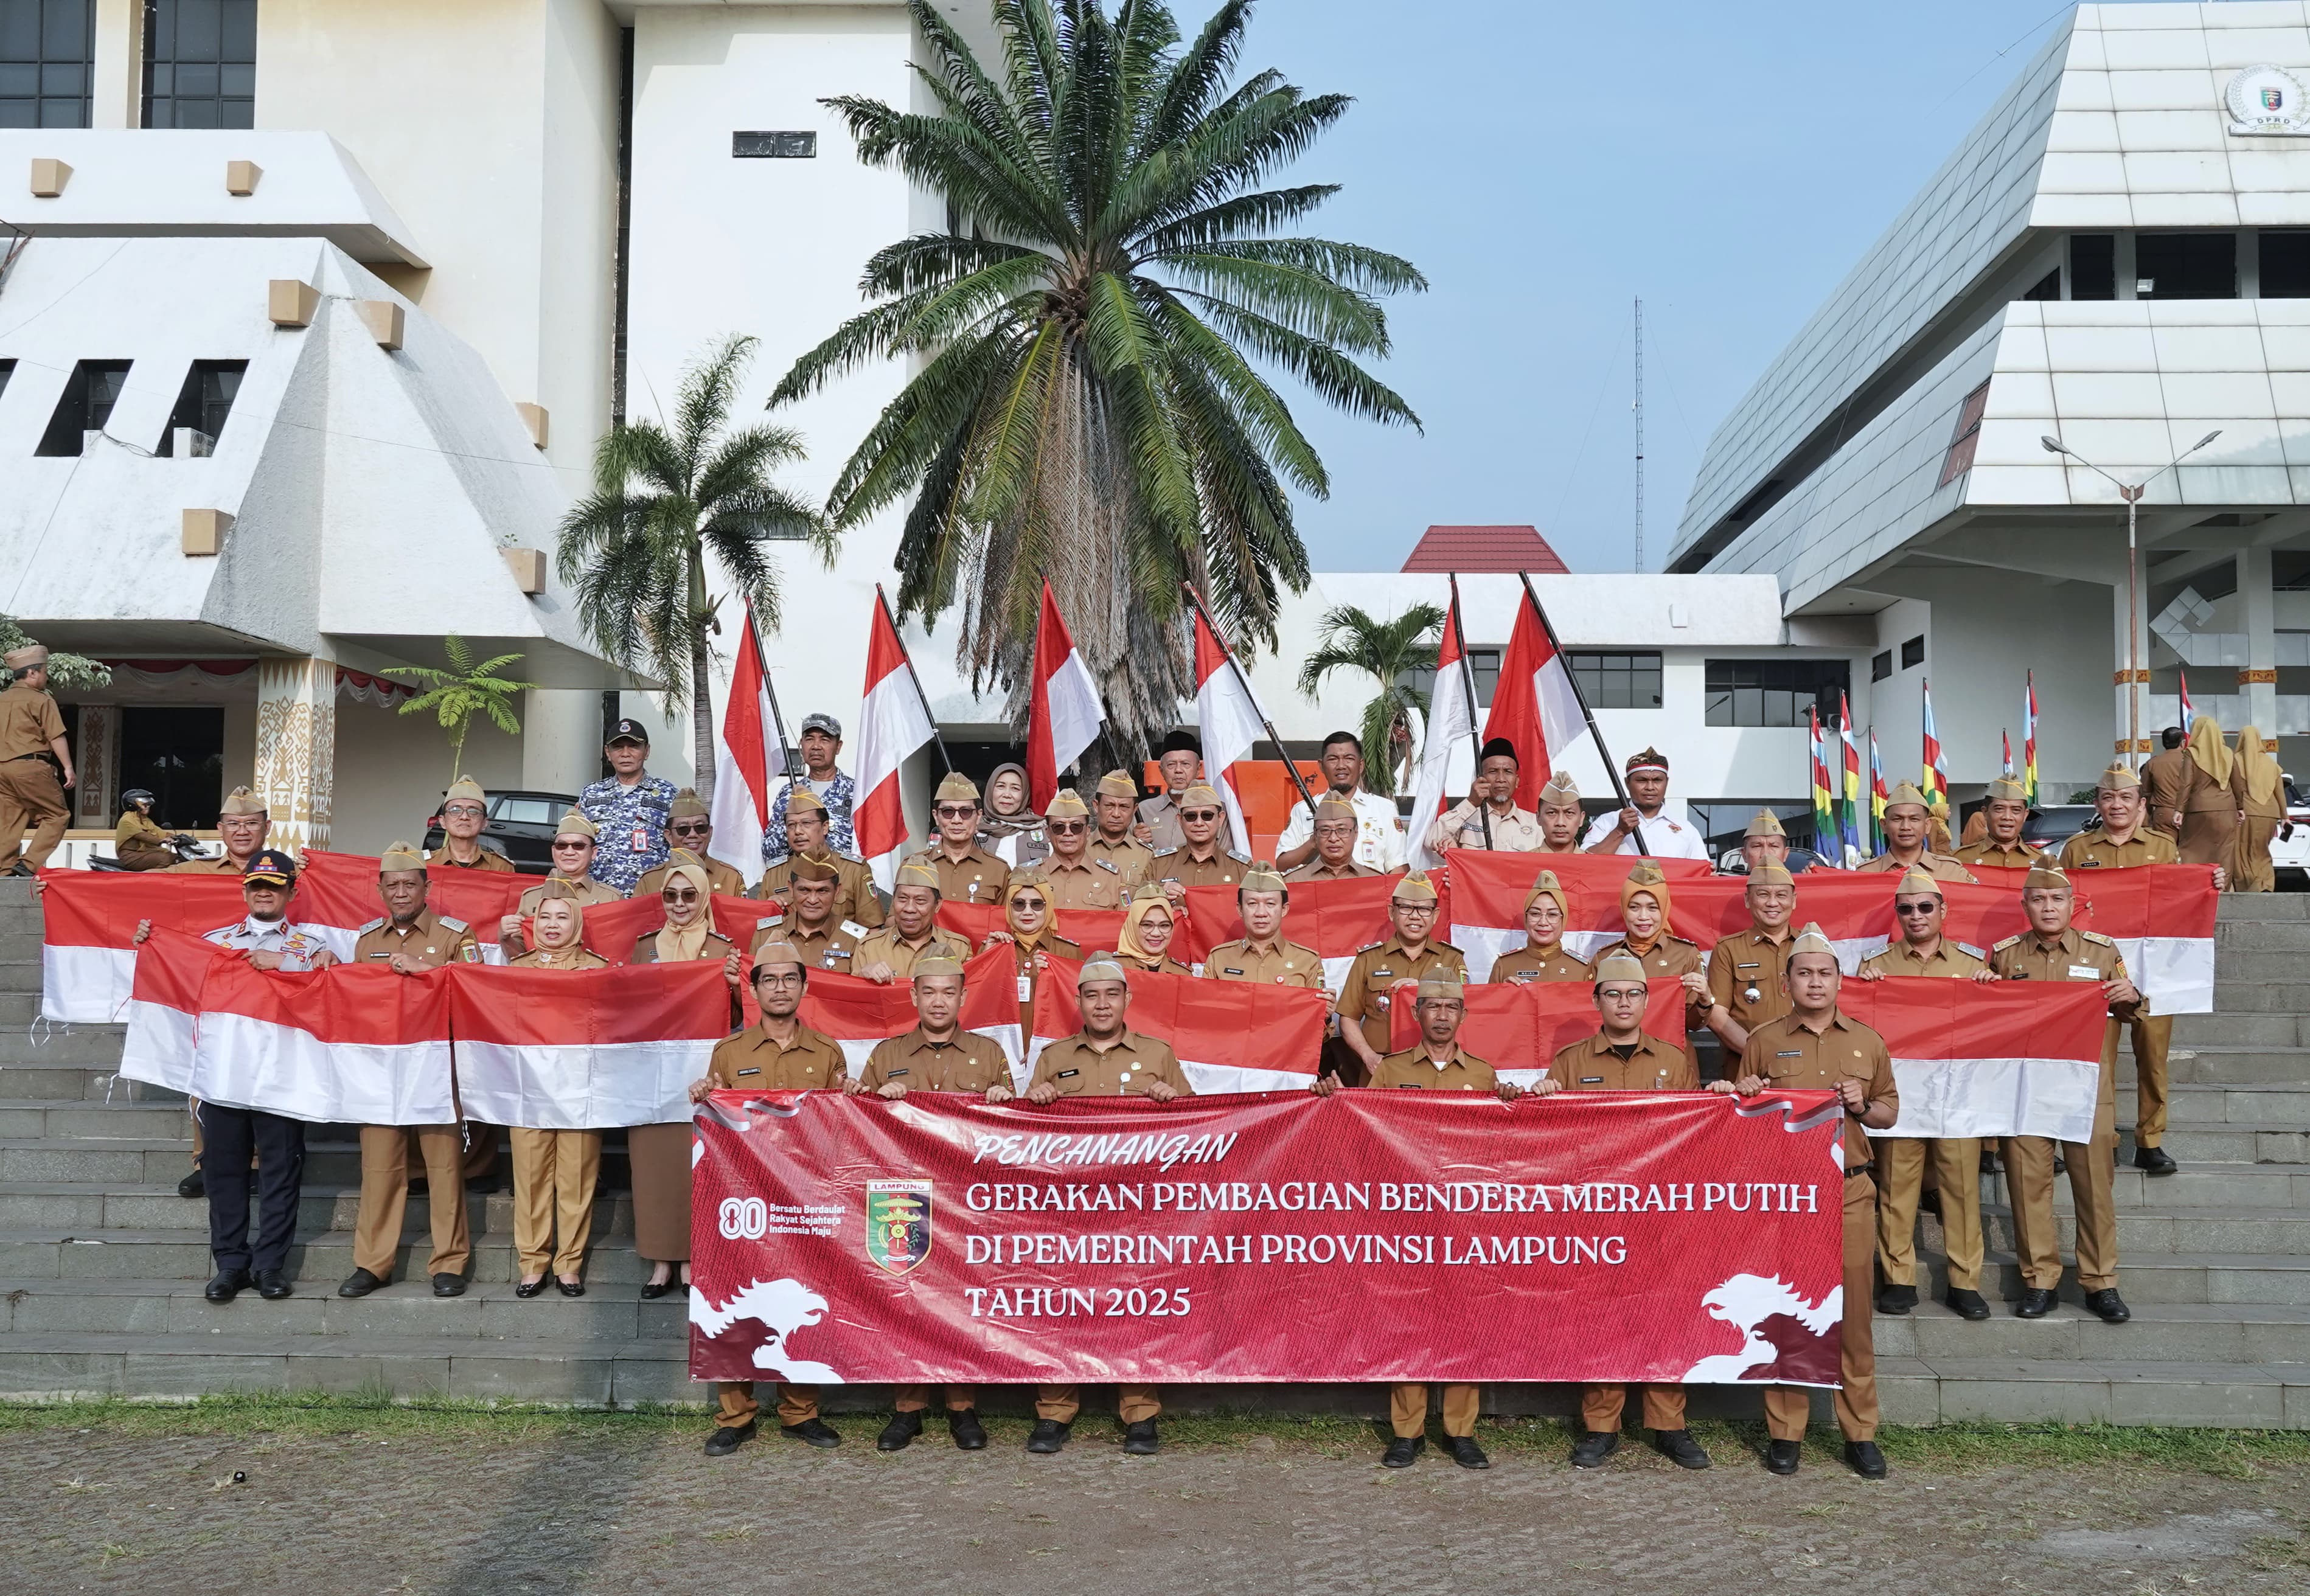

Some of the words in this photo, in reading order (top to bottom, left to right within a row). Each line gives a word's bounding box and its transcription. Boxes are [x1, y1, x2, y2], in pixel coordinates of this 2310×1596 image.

[973, 1132, 1238, 1173] PENCANANGAN
[769, 1202, 802, 1213] Bersatu
[803, 1204, 846, 1214] Berdaulat
[965, 1182, 1144, 1212] GERAKAN
[1152, 1182, 1371, 1211] PEMBAGIAN
[1380, 1182, 1553, 1212] BENDERA
[1562, 1183, 1694, 1212] MERAH
[1703, 1183, 1818, 1212] PUTIH
[718, 1196, 767, 1240] 80
[769, 1215, 798, 1225] Rakyat
[799, 1215, 841, 1226] Sejahtera
[769, 1224, 810, 1235] Indonesia
[811, 1226, 832, 1238] Maju
[965, 1235, 1003, 1264] DI
[1011, 1235, 1253, 1264] PEMERINTAH
[1261, 1235, 1435, 1263] PROVINSI
[1443, 1236, 1627, 1265] LAMPUNG
[964, 1288, 1096, 1317] TAHUN
[1104, 1287, 1191, 1316] 2025
